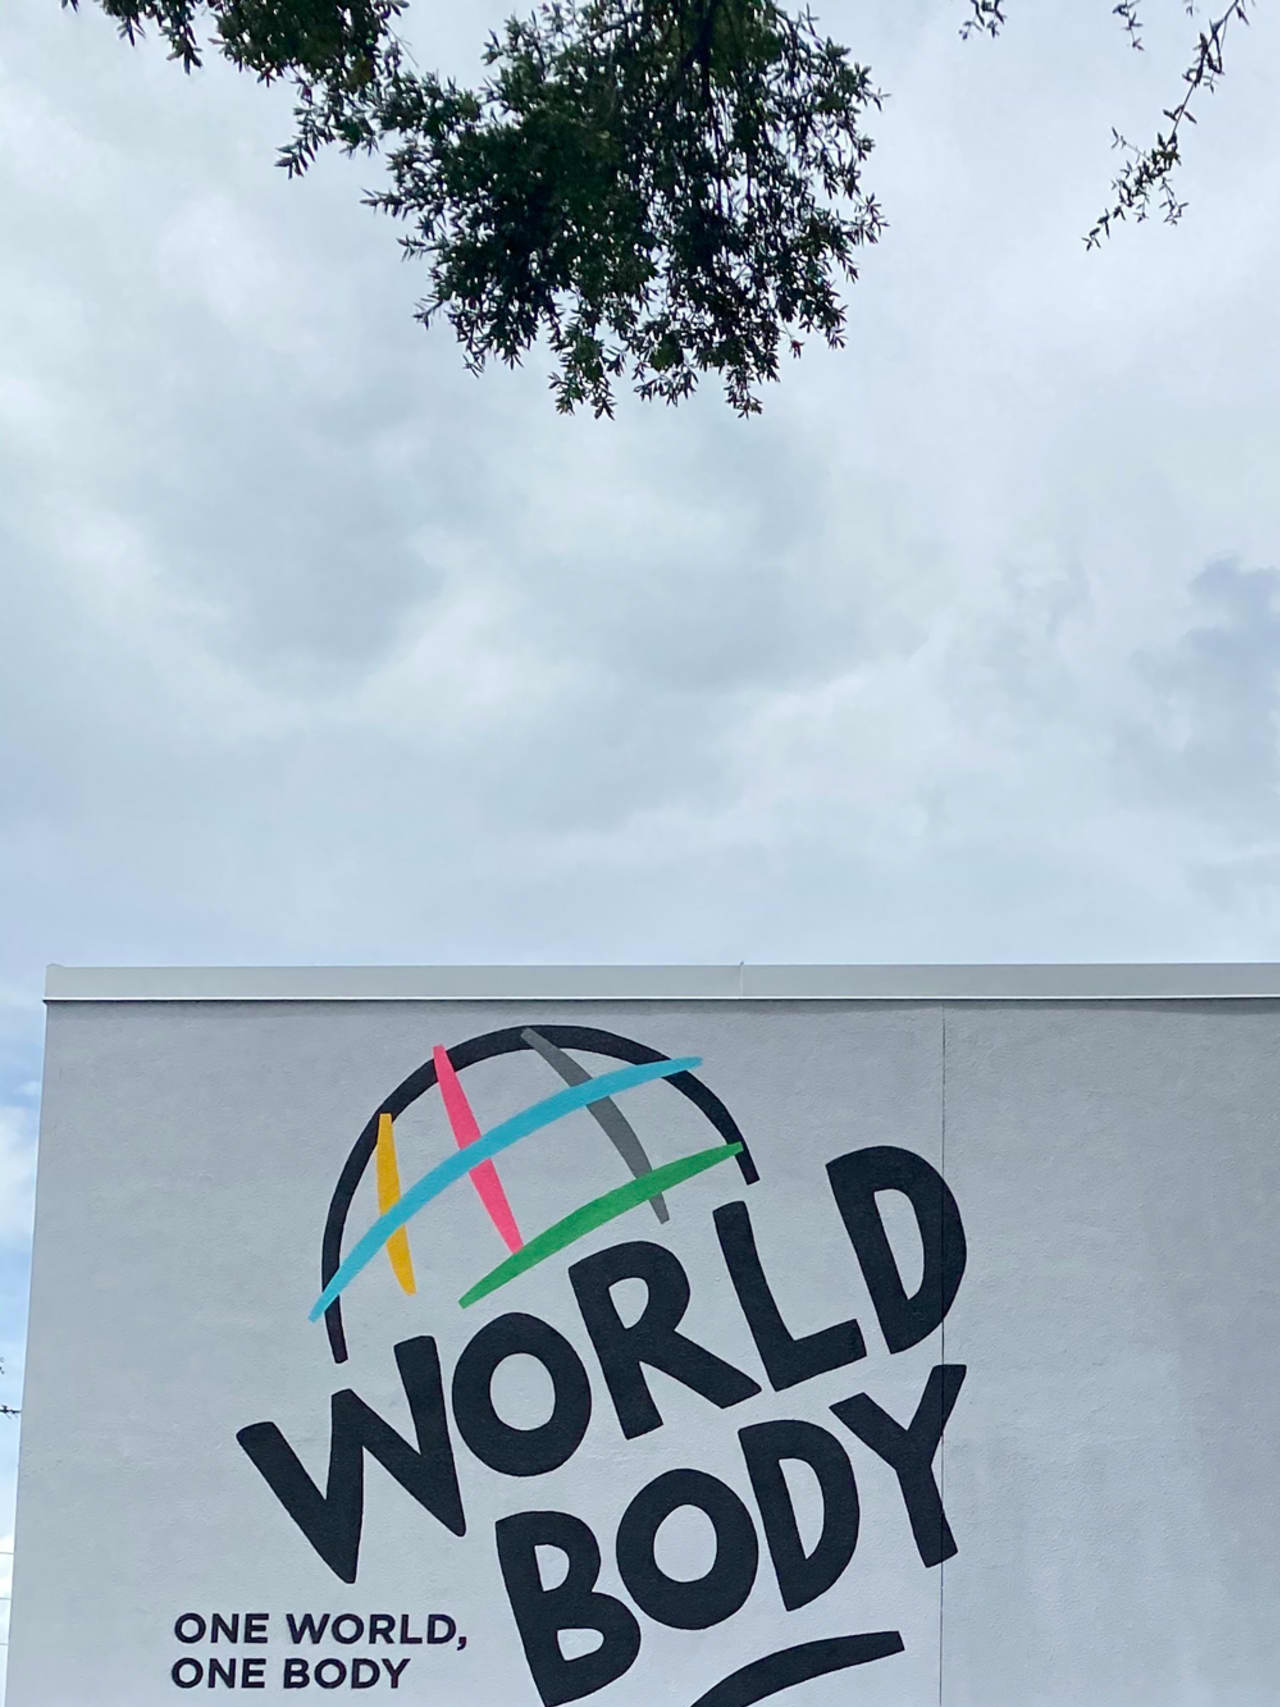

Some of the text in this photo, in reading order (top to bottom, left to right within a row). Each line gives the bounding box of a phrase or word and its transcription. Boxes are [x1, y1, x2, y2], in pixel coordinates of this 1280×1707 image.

[235, 1145, 967, 1585] WORLD
[174, 1612, 468, 1651] ONE WORLD,
[171, 1657, 411, 1690] ONE BODY
